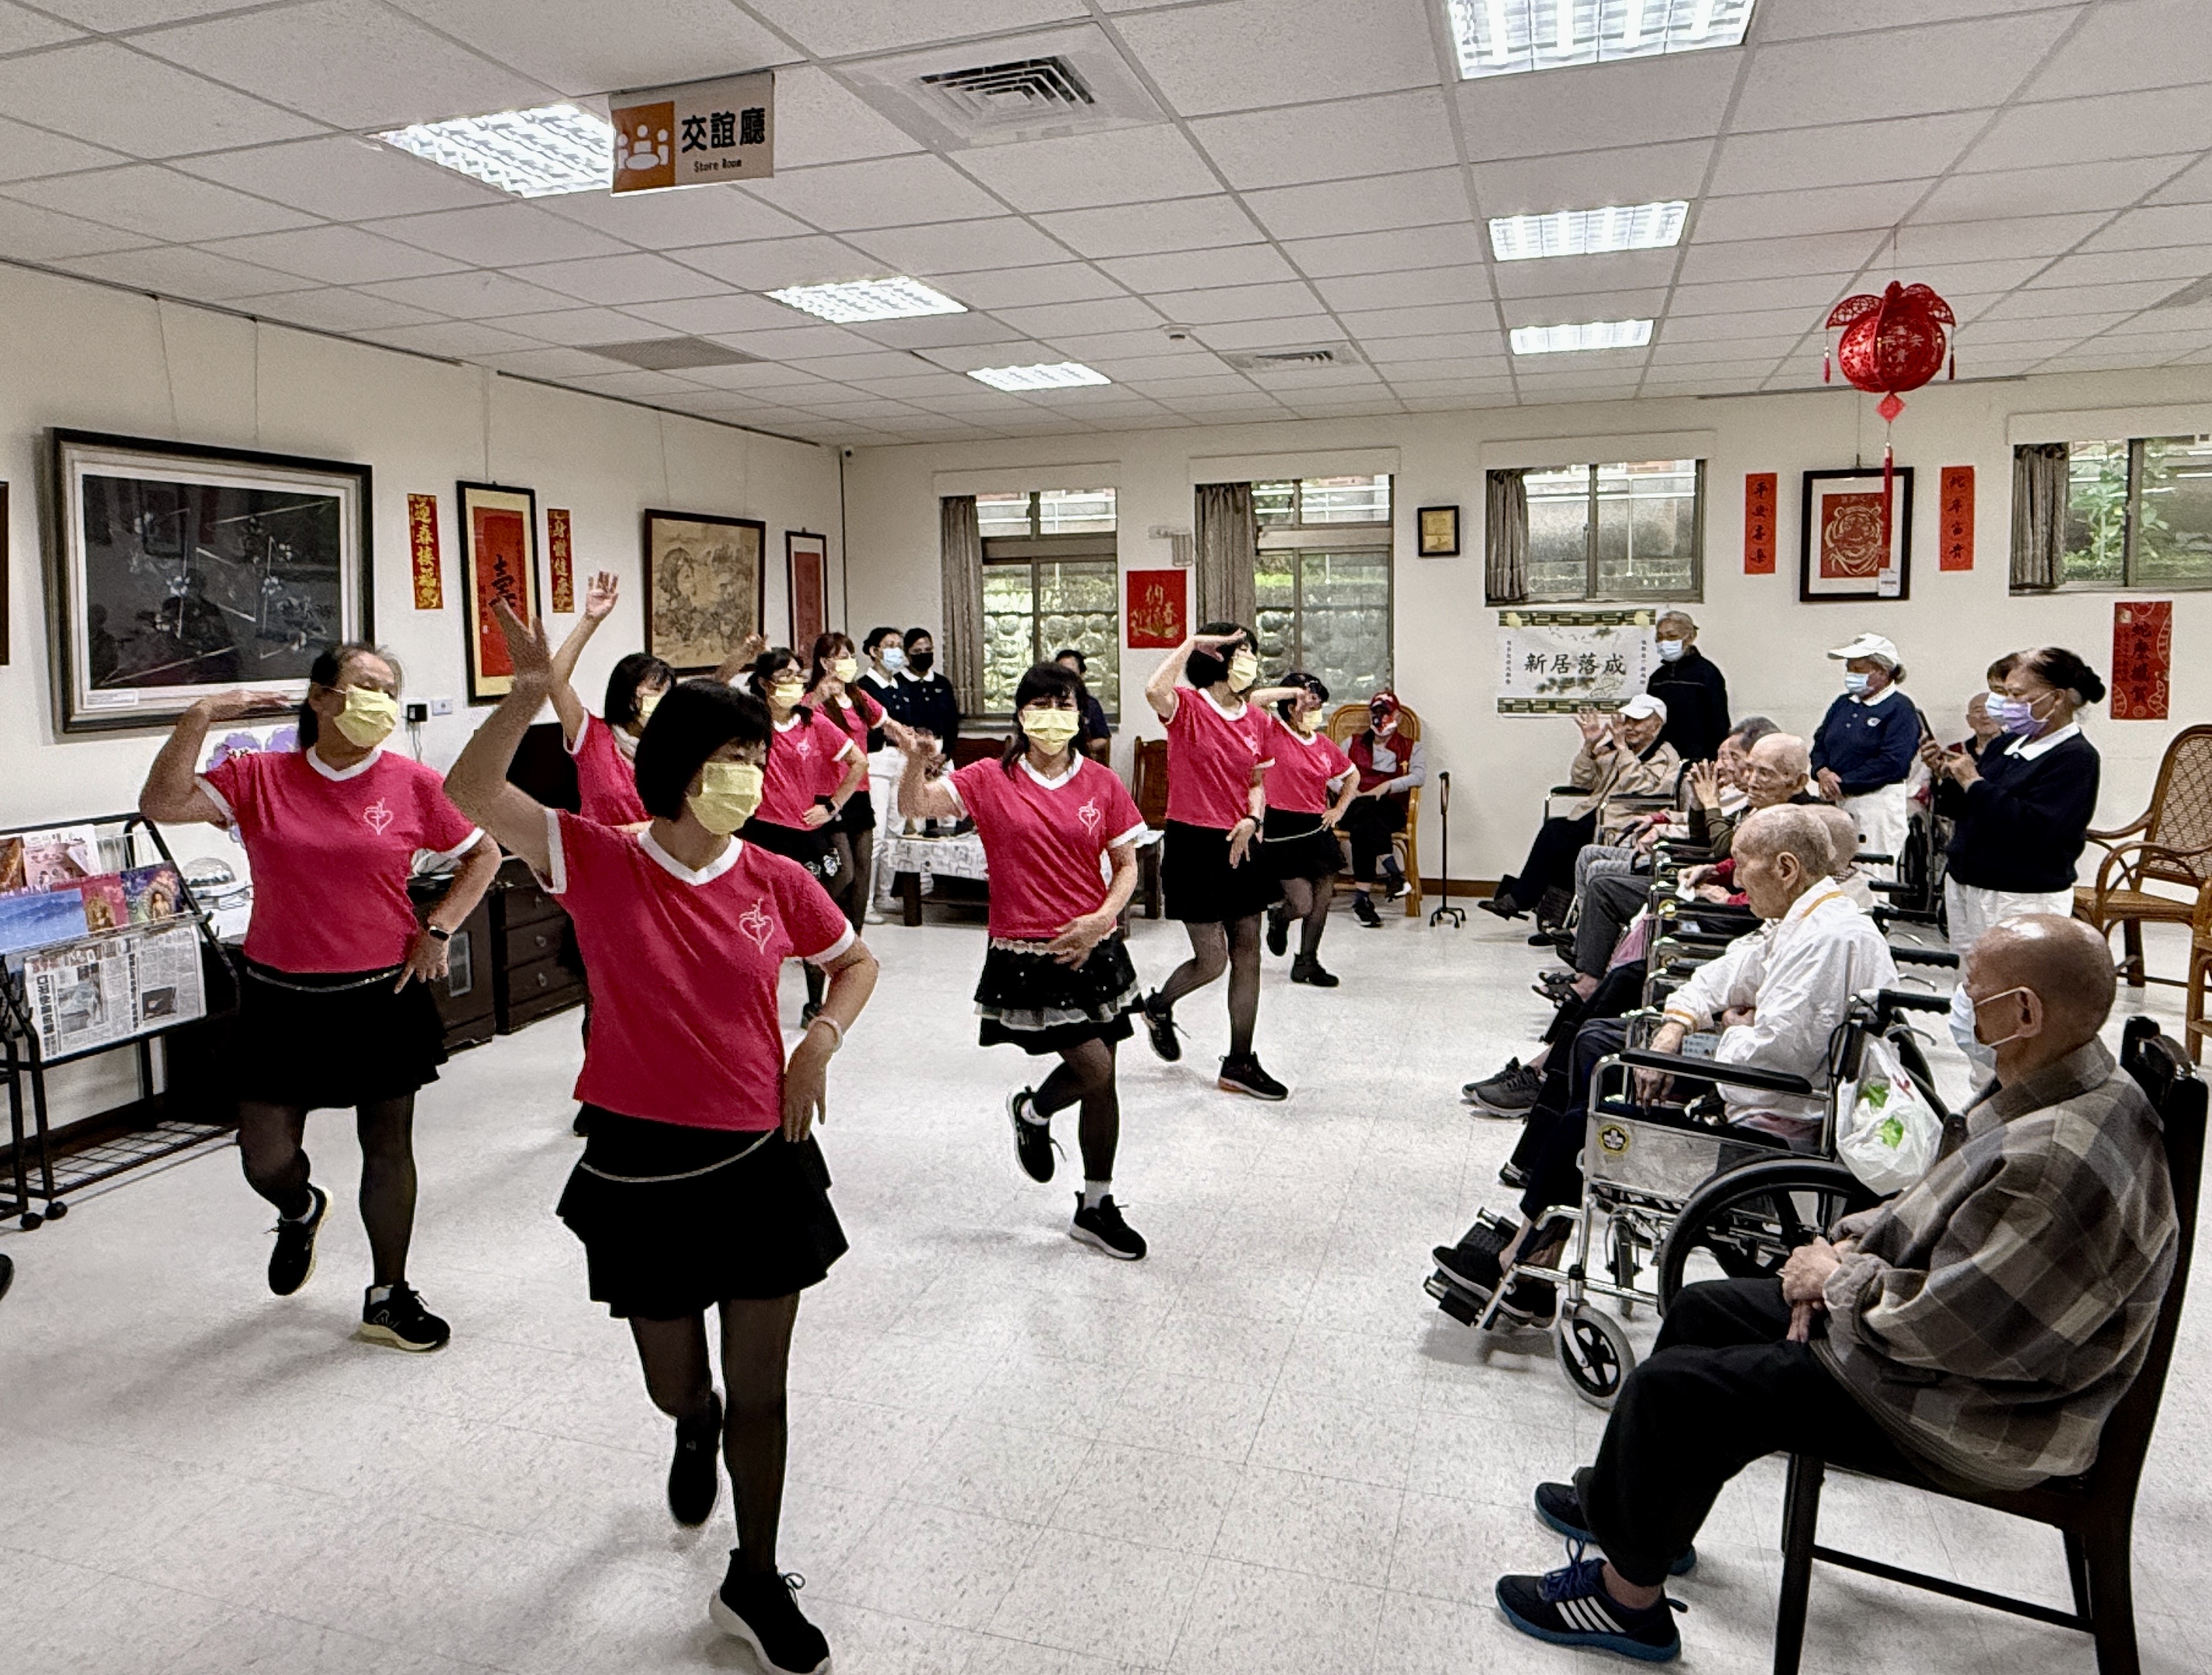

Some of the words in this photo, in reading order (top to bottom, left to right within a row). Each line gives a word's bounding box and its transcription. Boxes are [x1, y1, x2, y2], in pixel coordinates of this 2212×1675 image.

[681, 107, 765, 153] 交誼廳
[694, 160, 719, 172] Store
[722, 158, 741, 168] Room
[1524, 652, 1627, 675] 新居落成
